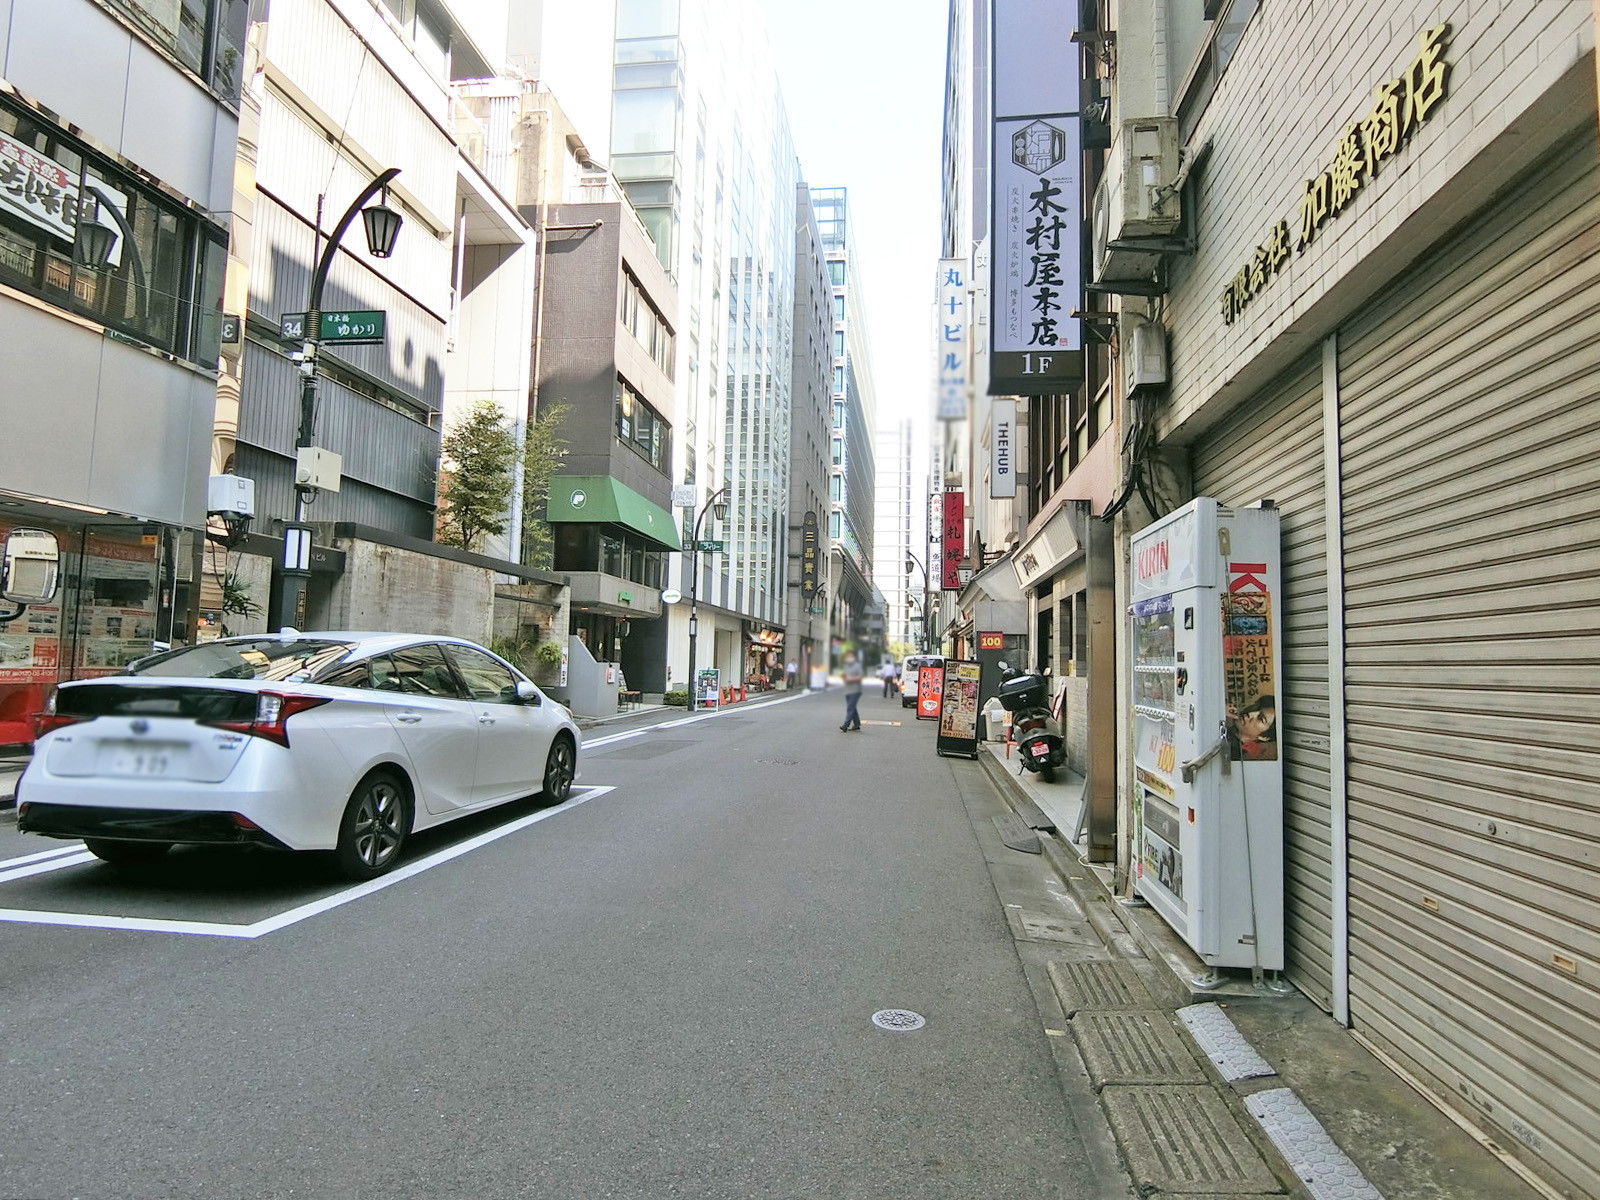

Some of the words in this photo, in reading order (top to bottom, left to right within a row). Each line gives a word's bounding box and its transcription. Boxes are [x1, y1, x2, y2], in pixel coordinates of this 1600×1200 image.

[1221, 220, 1289, 325] 有限会社
[1297, 23, 1451, 251] 加藤商店
[1024, 177, 1068, 346] 木村屋本店
[283, 322, 302, 336] 34
[338, 323, 376, 337] ゆかり
[943, 267, 964, 371] 丸十ビル
[1021, 353, 1053, 374] 1F
[946, 526, 962, 585] 札幌や
[1138, 538, 1169, 580] KIRIN
[981, 636, 1001, 647] 100
[1258, 638, 1271, 684] コーヒーは
[921, 669, 931, 699] 札幌や
